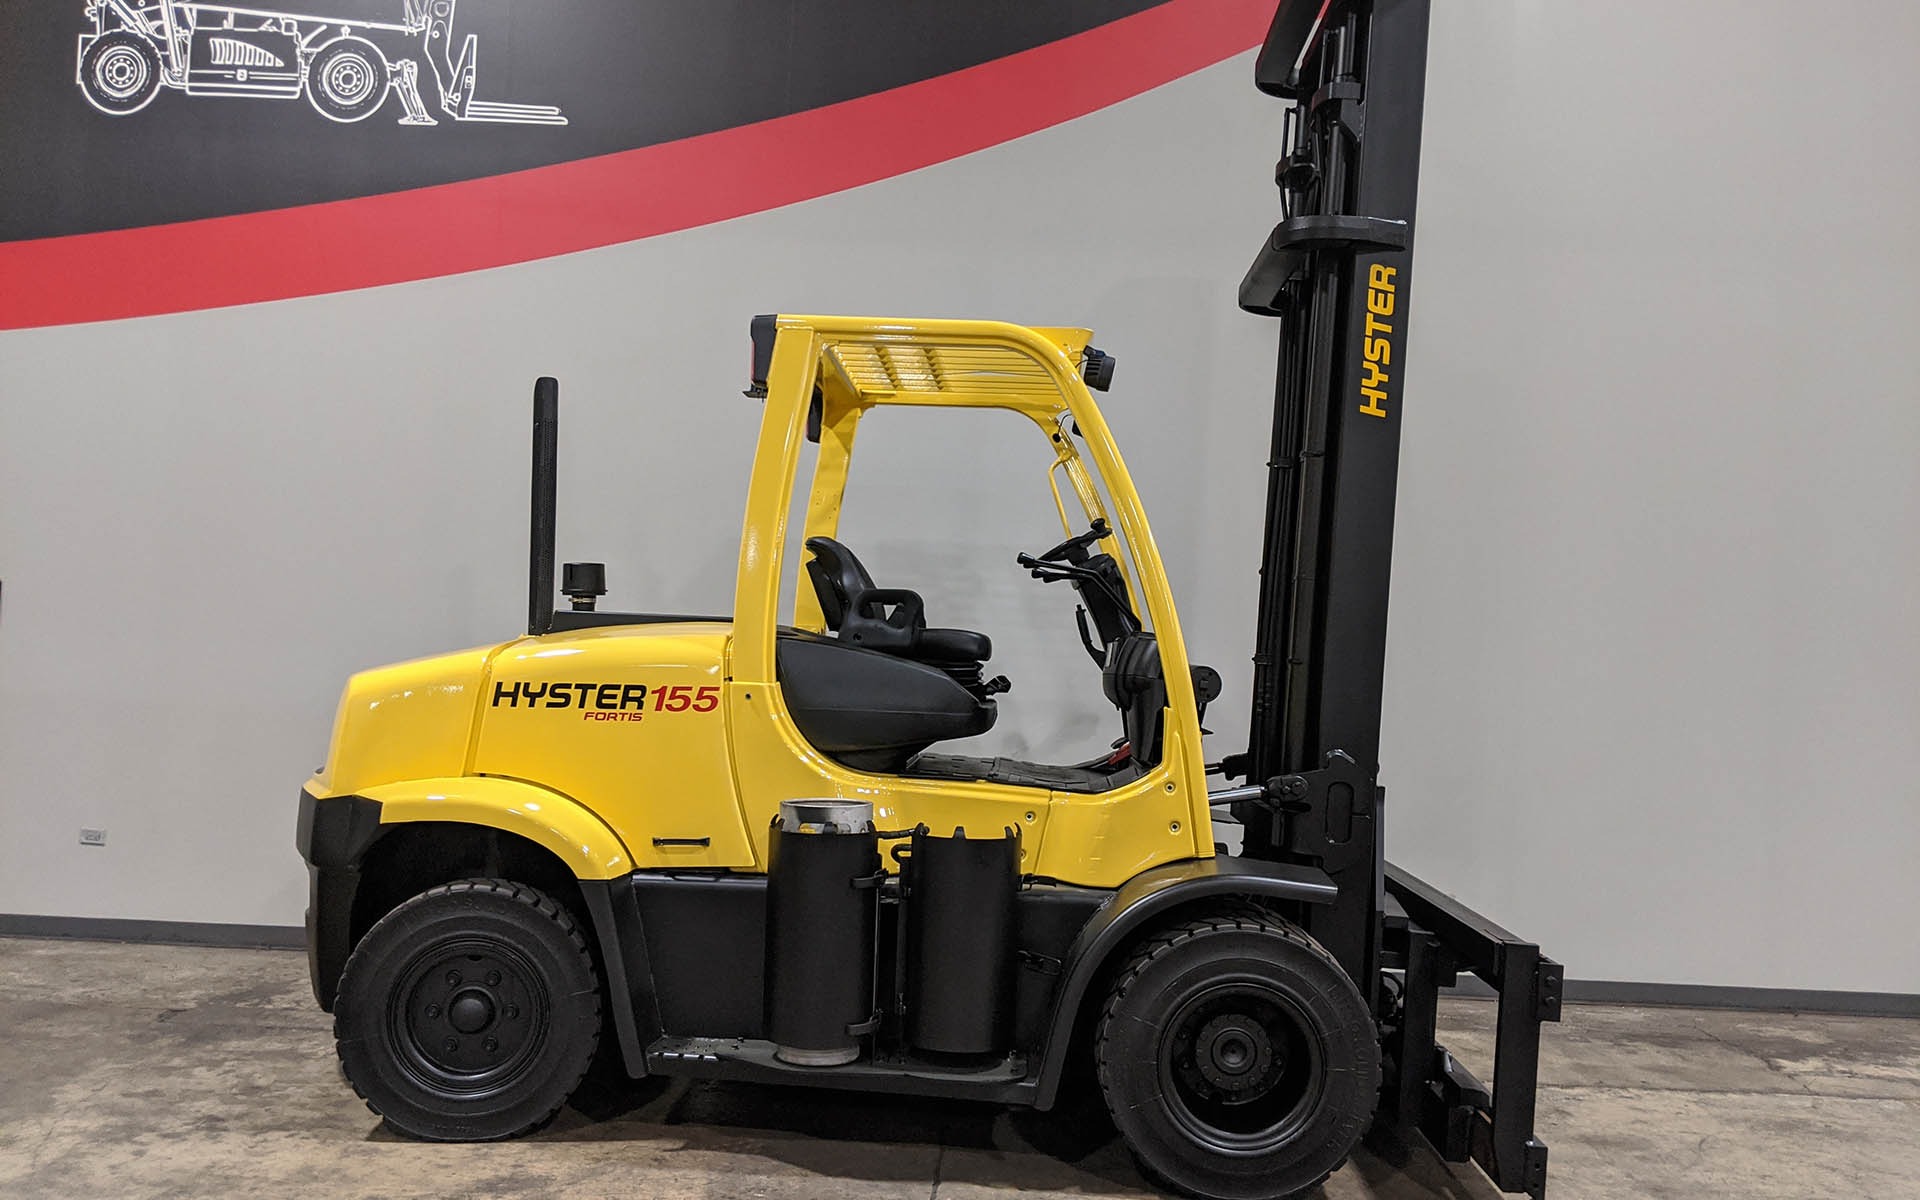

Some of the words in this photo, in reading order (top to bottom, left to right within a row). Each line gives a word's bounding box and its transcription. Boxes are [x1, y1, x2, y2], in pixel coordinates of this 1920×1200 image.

[1359, 263, 1396, 418] HYSTER
[492, 681, 647, 710] HYSTER
[650, 685, 720, 712] 155
[583, 712, 643, 722] FORTIS
